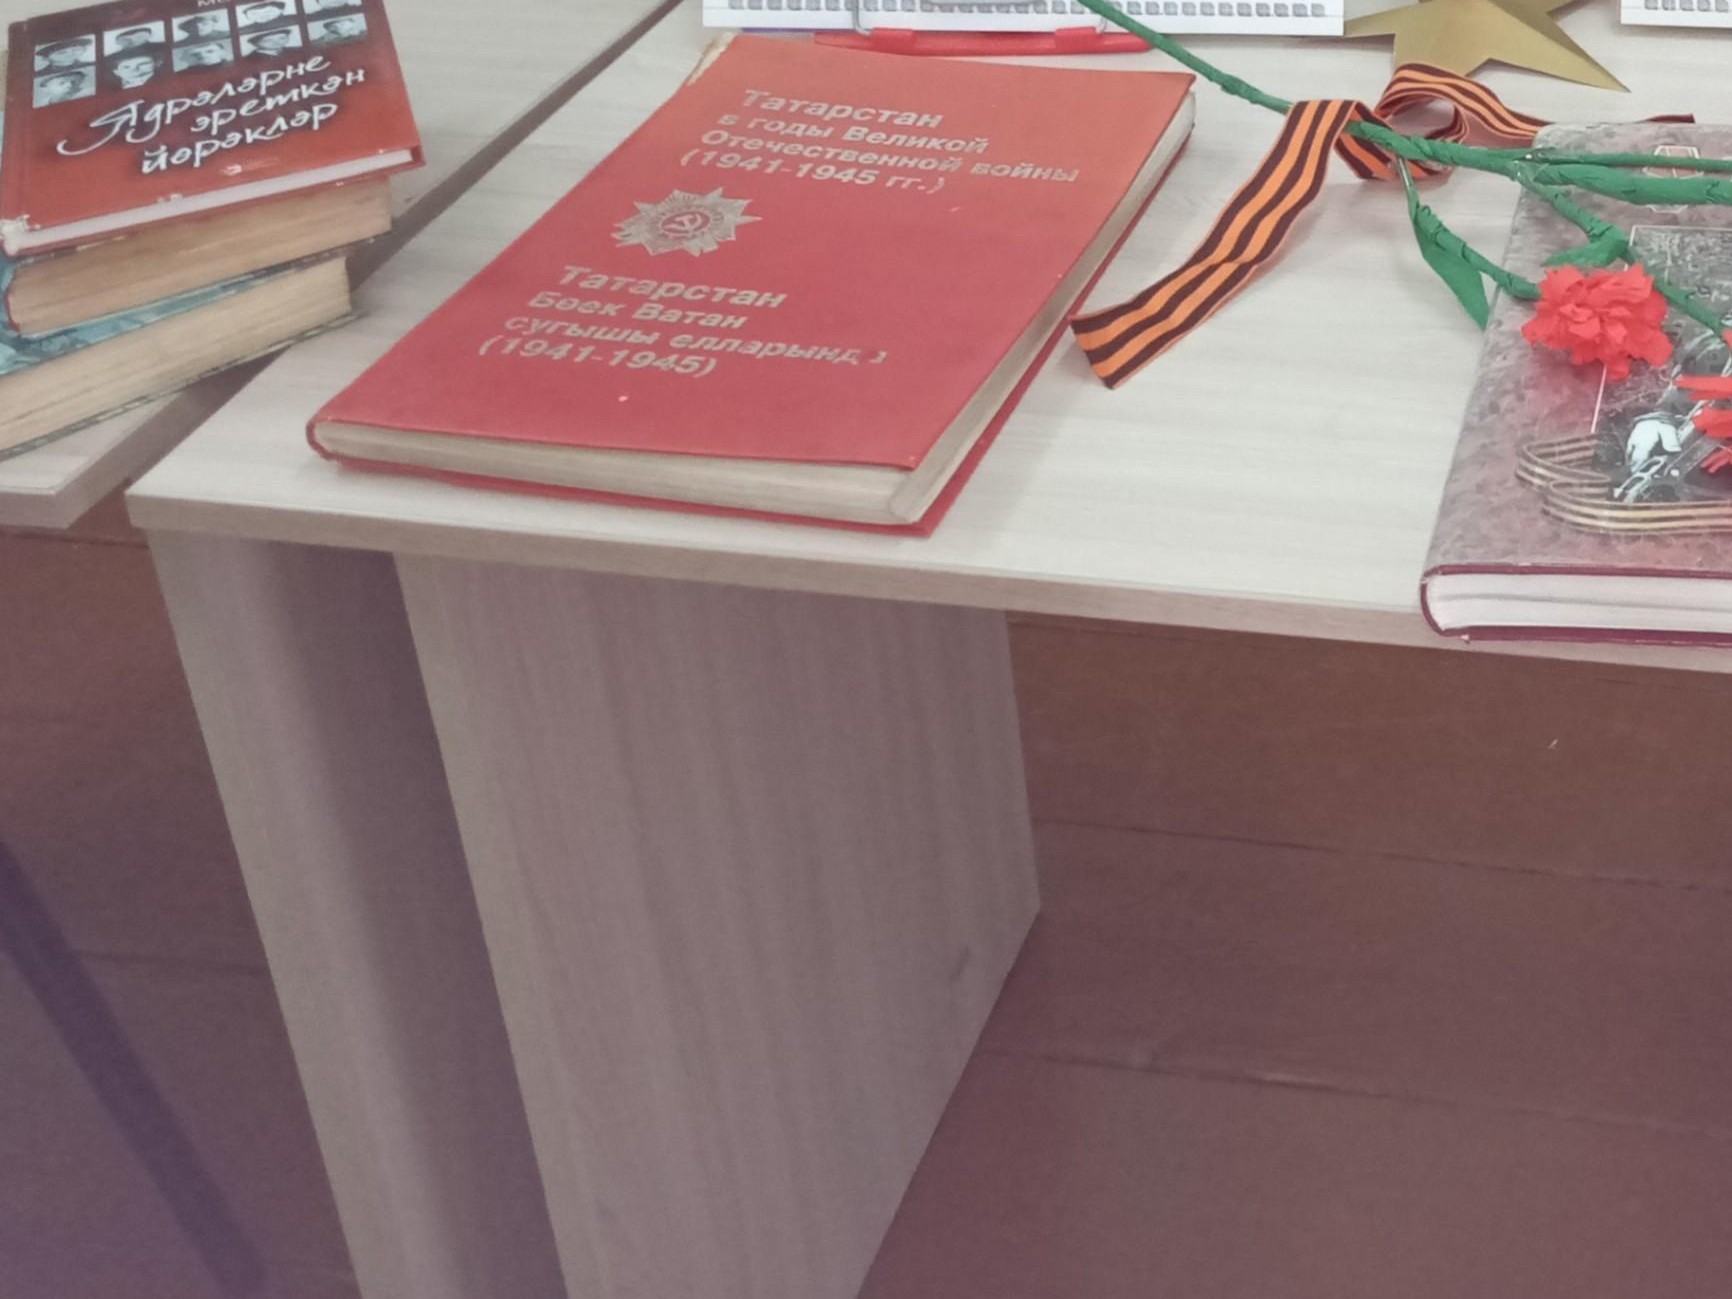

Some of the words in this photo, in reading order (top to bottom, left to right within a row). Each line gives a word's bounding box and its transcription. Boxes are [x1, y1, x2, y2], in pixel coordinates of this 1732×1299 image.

[742, 90, 944, 128] Татарстан
[718, 114, 736, 126] в
[747, 116, 832, 138] годы
[842, 126, 989, 154] Великой
[680, 148, 878, 186] (1941-1945
[701, 130, 963, 173] Отечественной
[971, 161, 1079, 183] войны
[558, 265, 787, 309] Татарстан
[505, 315, 660, 346] сугышы
[632, 302, 749, 329] Ватан
[478, 335, 717, 379] (1941-1945)
